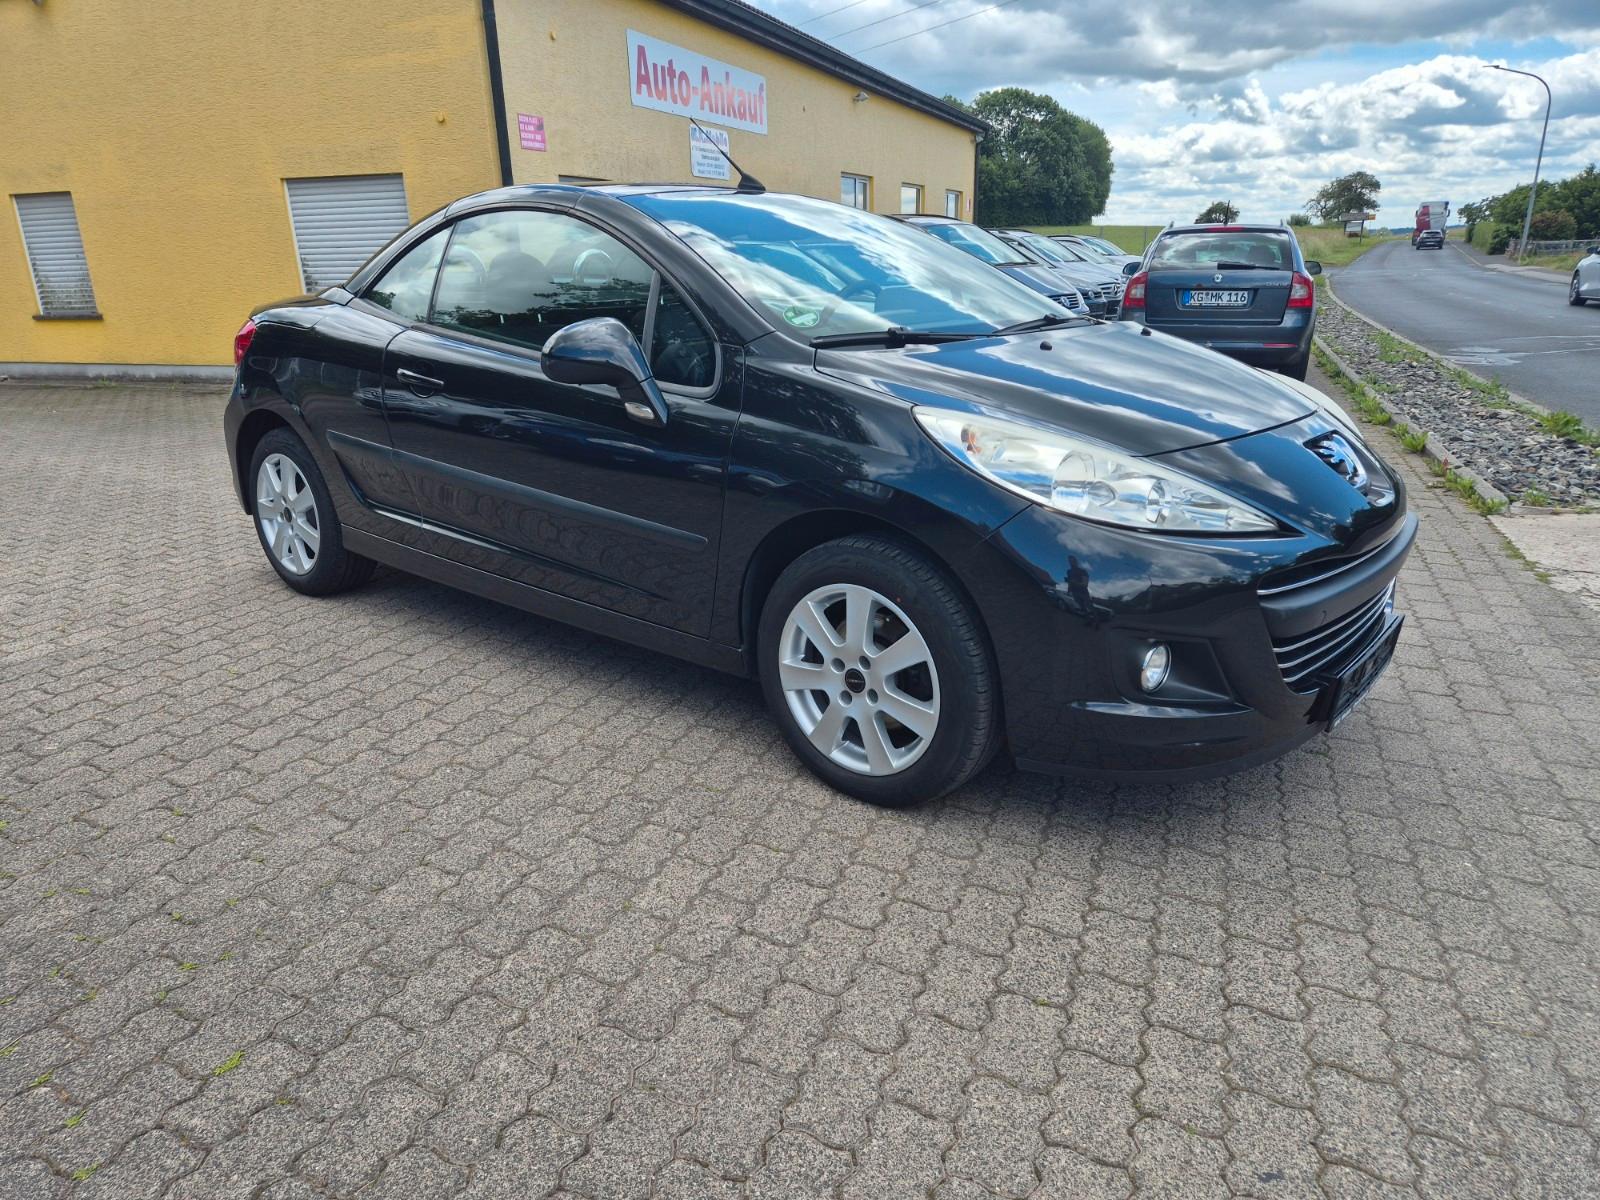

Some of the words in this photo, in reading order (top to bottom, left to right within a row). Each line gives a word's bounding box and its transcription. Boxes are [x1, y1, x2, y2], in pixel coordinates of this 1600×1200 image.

[636, 44, 765, 126] Auto-Ankauf
[1190, 292, 1204, 301] KG
[1210, 292, 1225, 301] MK
[1226, 292, 1247, 303] 116
